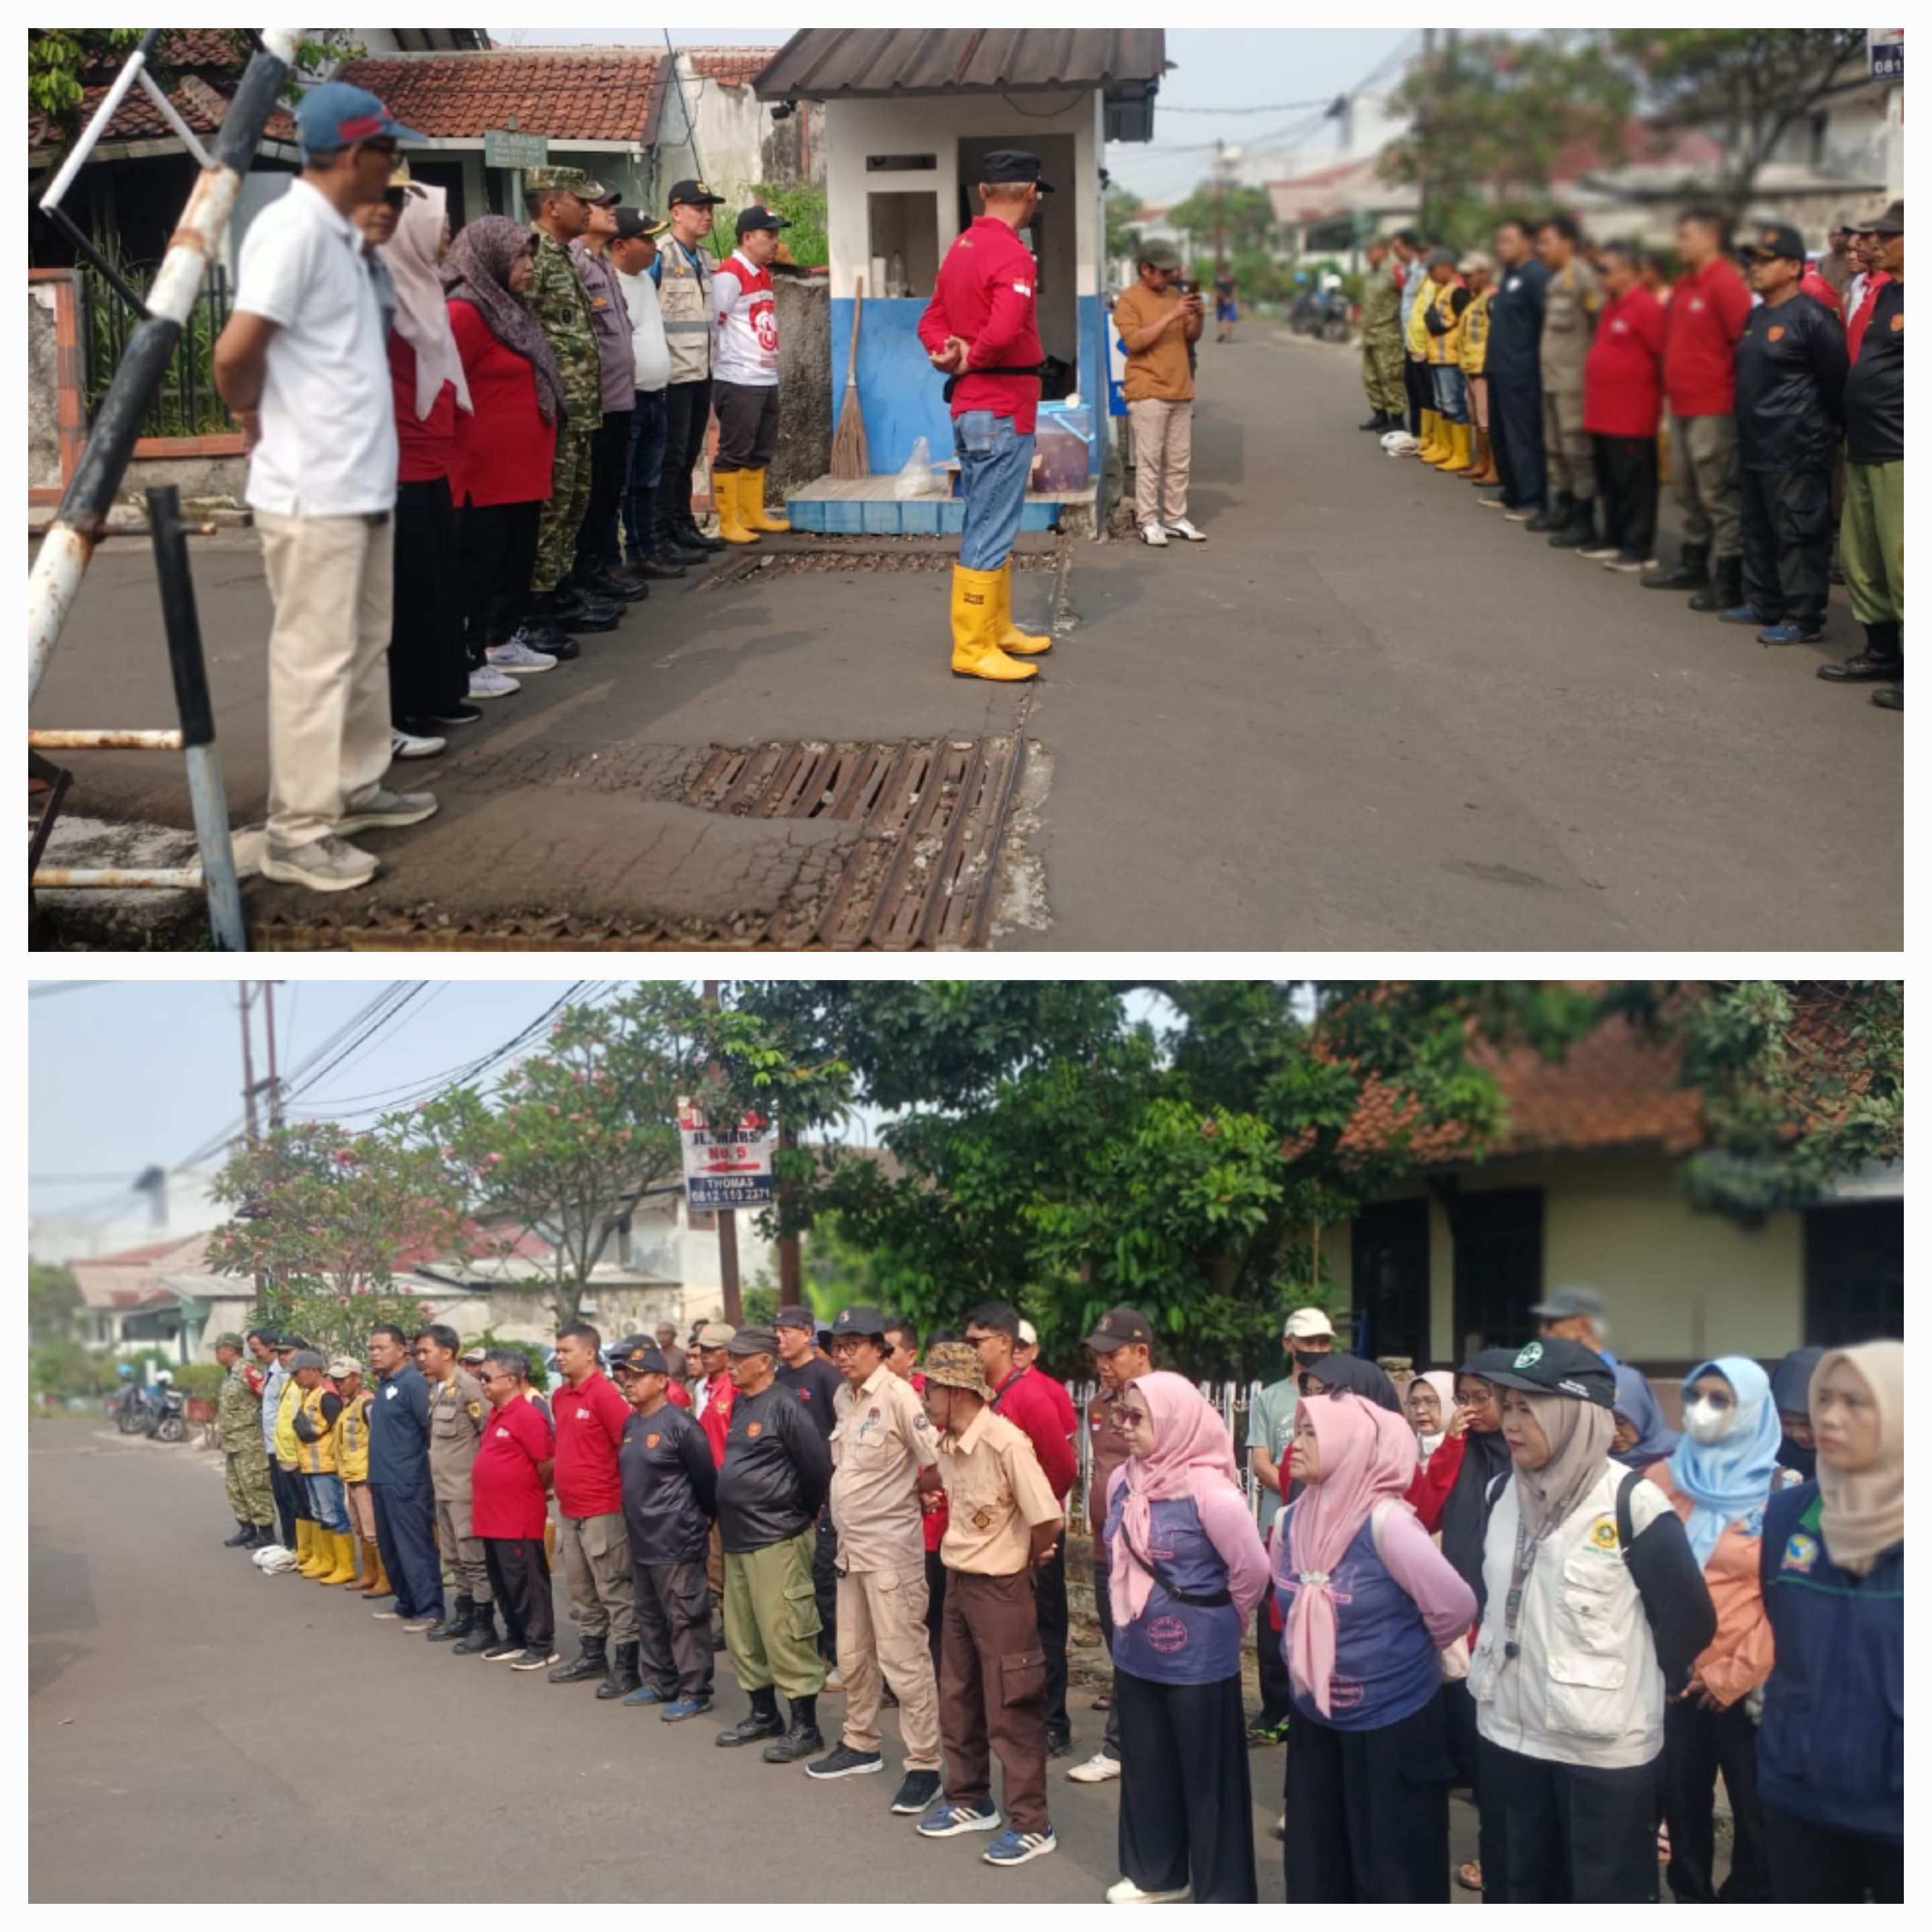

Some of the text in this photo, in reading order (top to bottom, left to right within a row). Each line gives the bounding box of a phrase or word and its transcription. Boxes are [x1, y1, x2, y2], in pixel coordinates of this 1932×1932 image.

[1874, 59, 1904, 74] 081
[708, 1146, 746, 1159] No. 5
[706, 1177, 753, 1188] THOMAS
[692, 1191, 720, 1202] 0812
